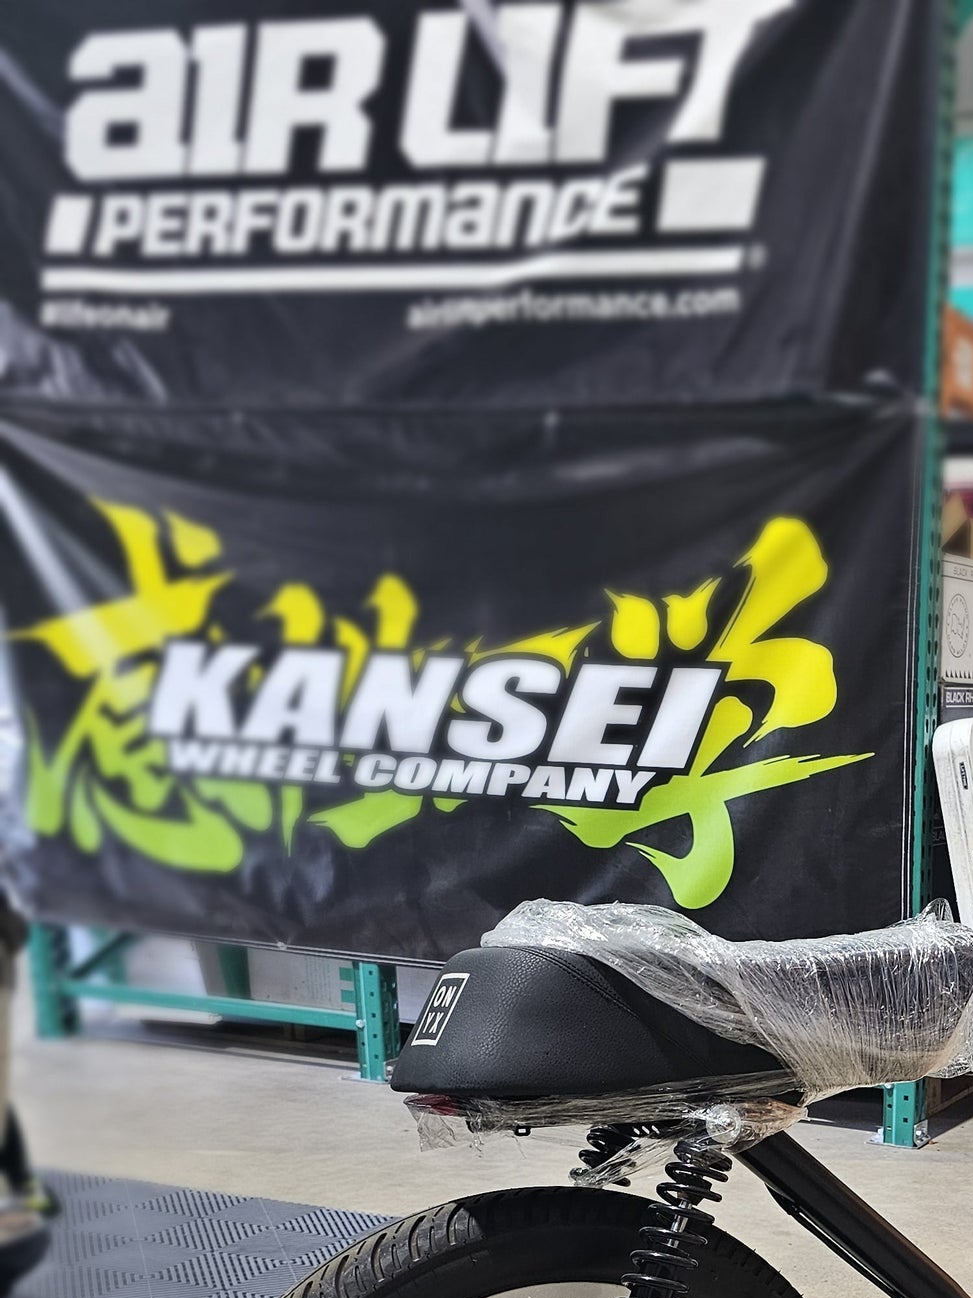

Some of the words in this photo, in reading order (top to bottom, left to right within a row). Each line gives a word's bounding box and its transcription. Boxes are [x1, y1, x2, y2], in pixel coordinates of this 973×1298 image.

[152, 640, 723, 768] KANSEI
[945, 691, 965, 704] BLACK
[168, 739, 343, 785] WHEEL
[354, 752, 657, 804] COMPANY
